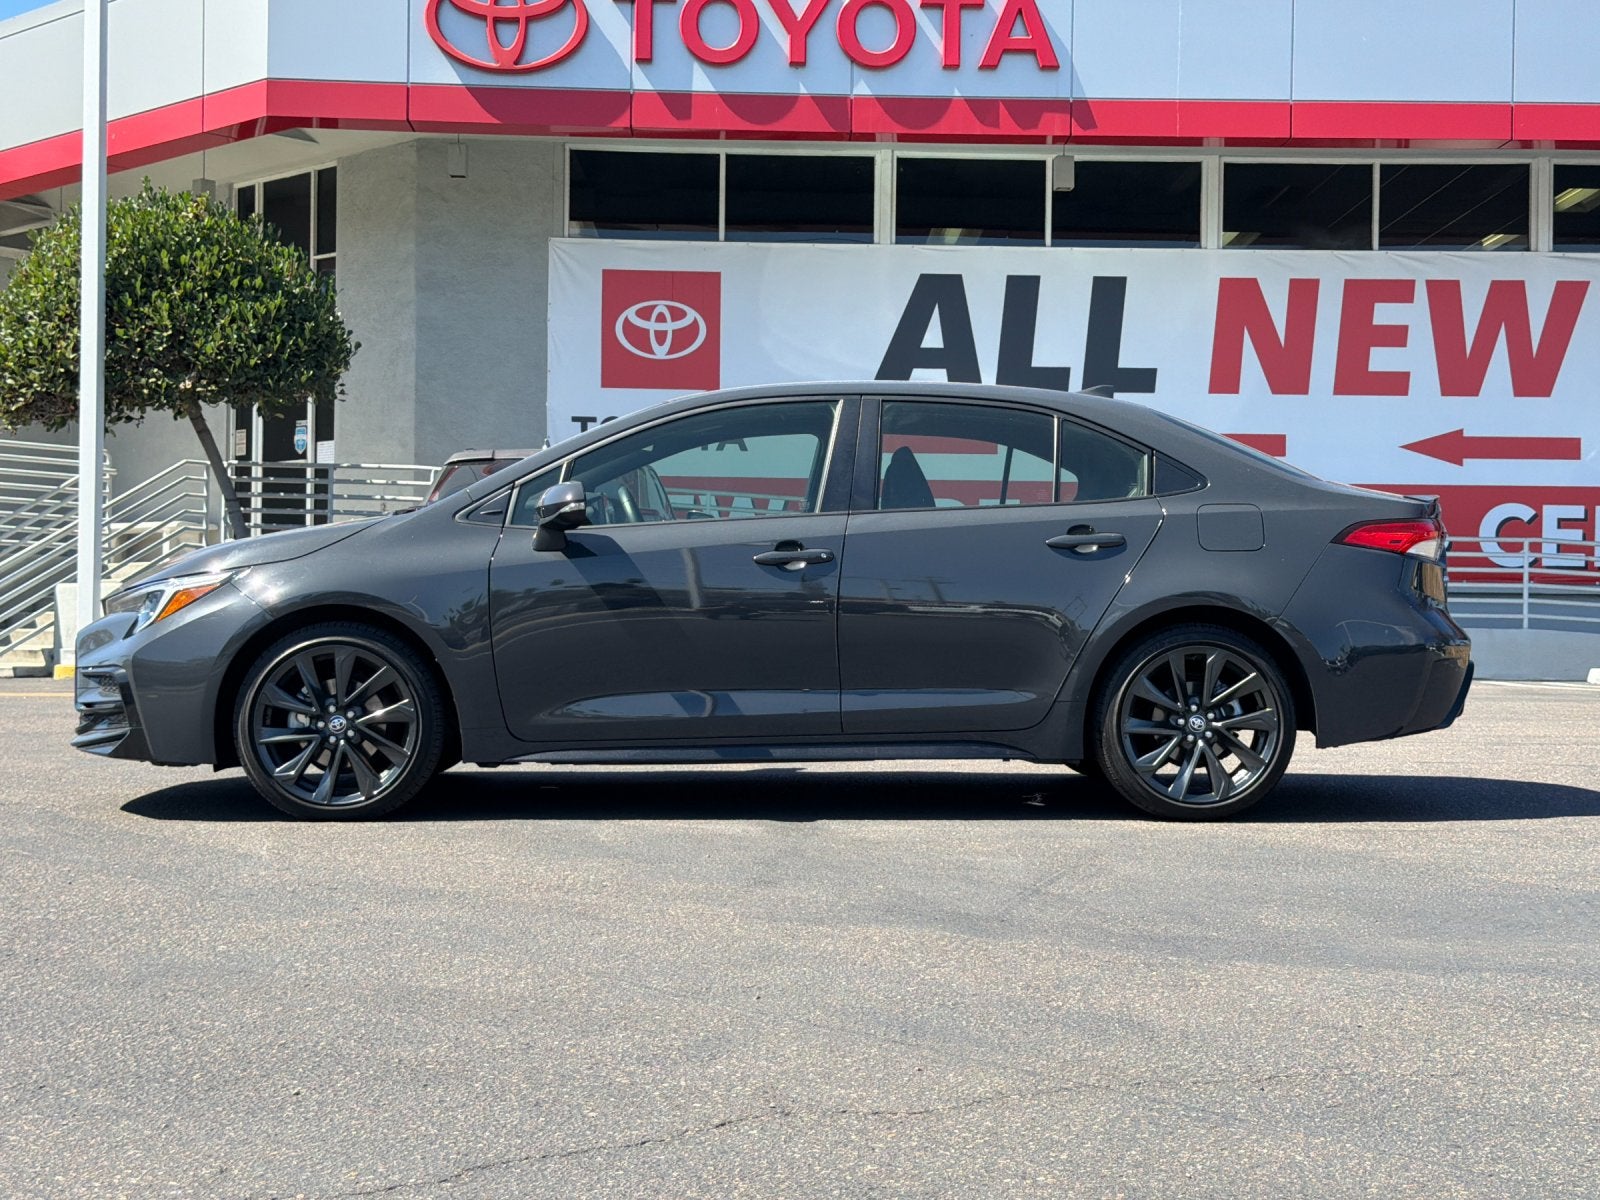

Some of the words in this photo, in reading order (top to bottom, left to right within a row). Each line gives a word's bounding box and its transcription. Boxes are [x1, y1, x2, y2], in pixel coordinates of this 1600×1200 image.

[613, 0, 1060, 70] TOYOTA
[874, 273, 1158, 394] ALL
[1208, 277, 1591, 398] NEW
[1478, 502, 1600, 569] CE
